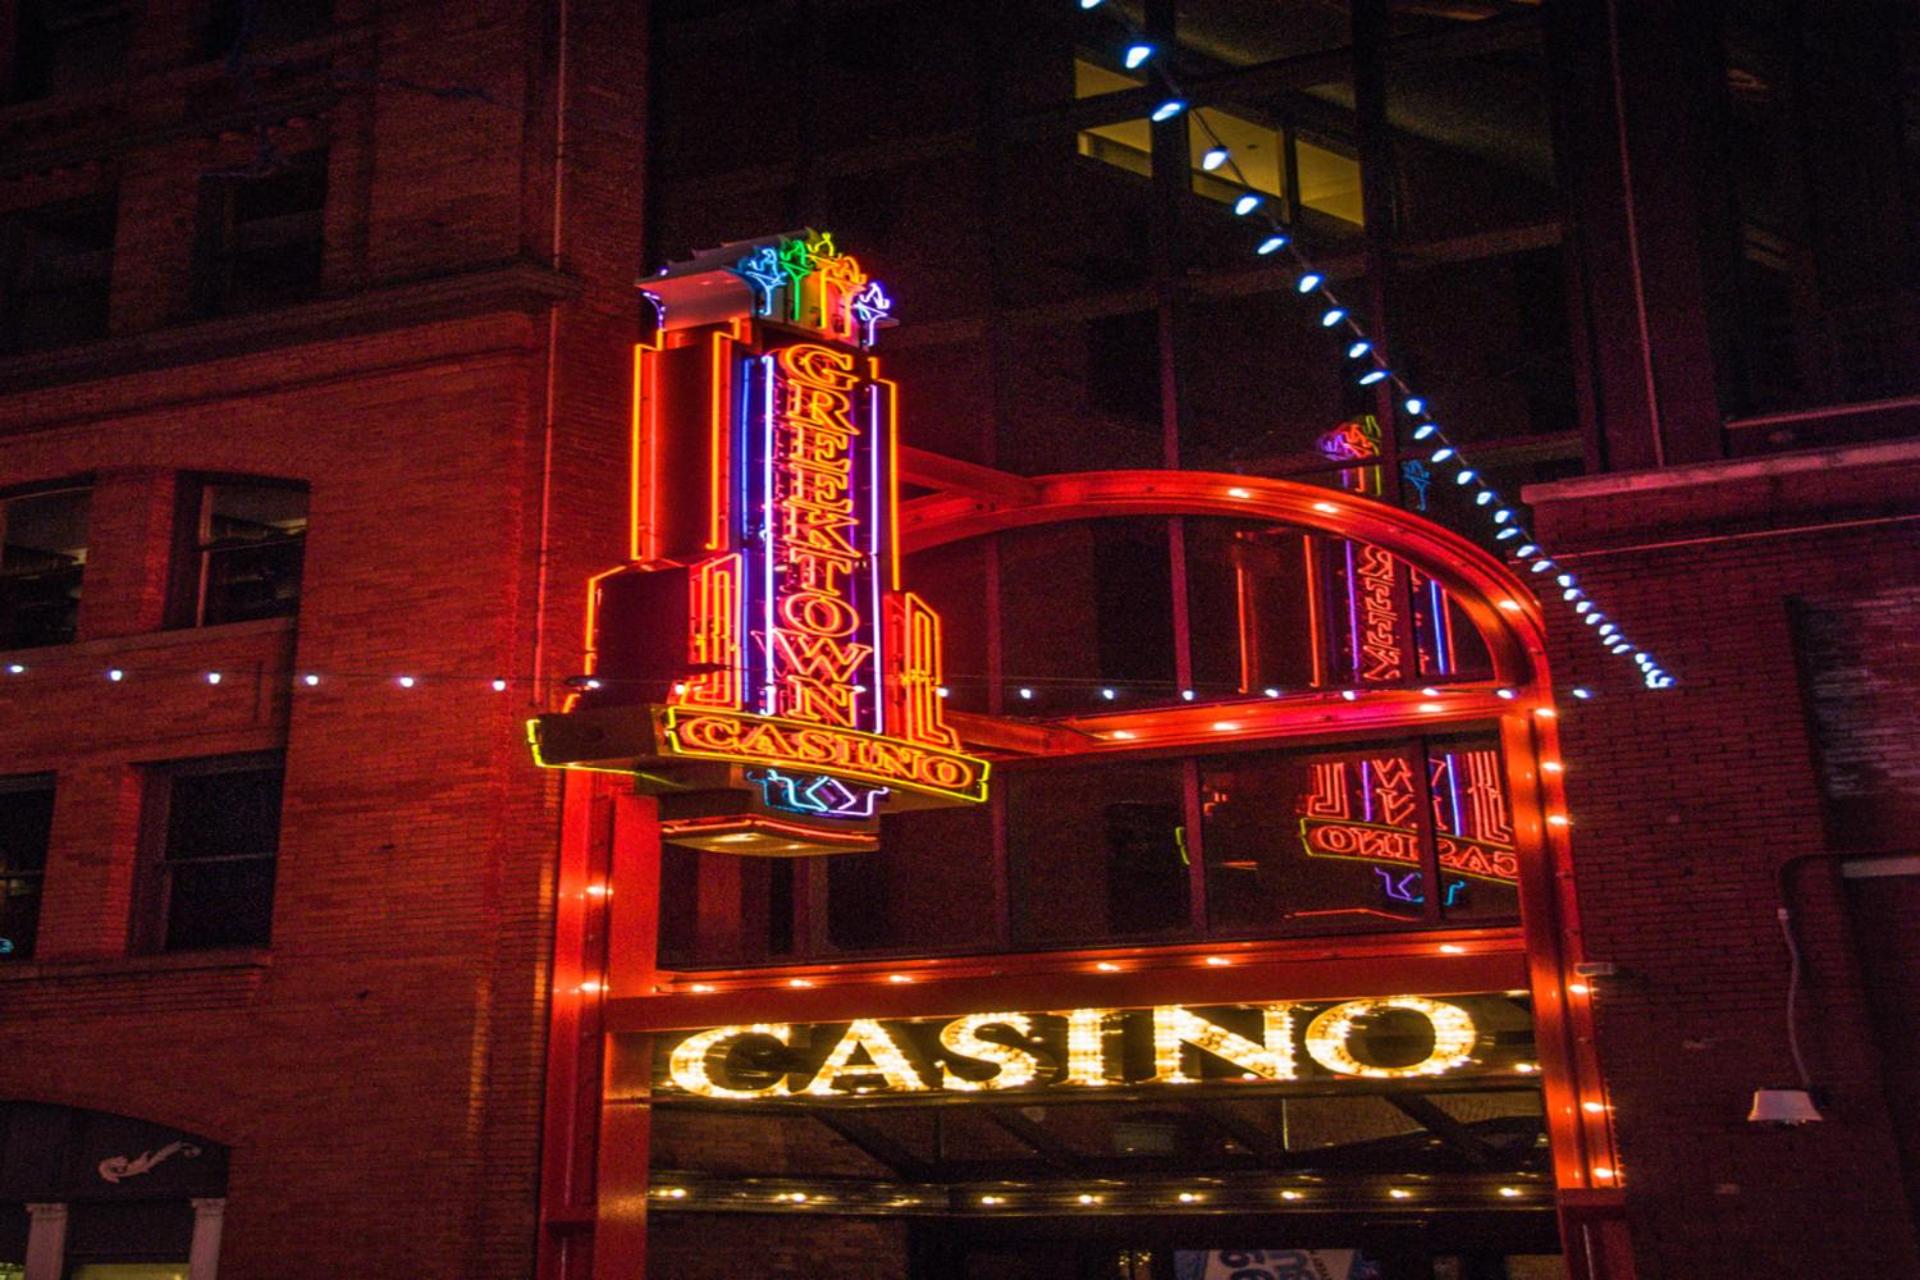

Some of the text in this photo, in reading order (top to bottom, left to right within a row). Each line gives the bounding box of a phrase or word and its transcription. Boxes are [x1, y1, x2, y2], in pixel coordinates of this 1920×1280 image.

[752, 344, 872, 728] GREEKTOWN
[684, 716, 975, 789] CASINO
[668, 995, 1477, 1100] CASINO
